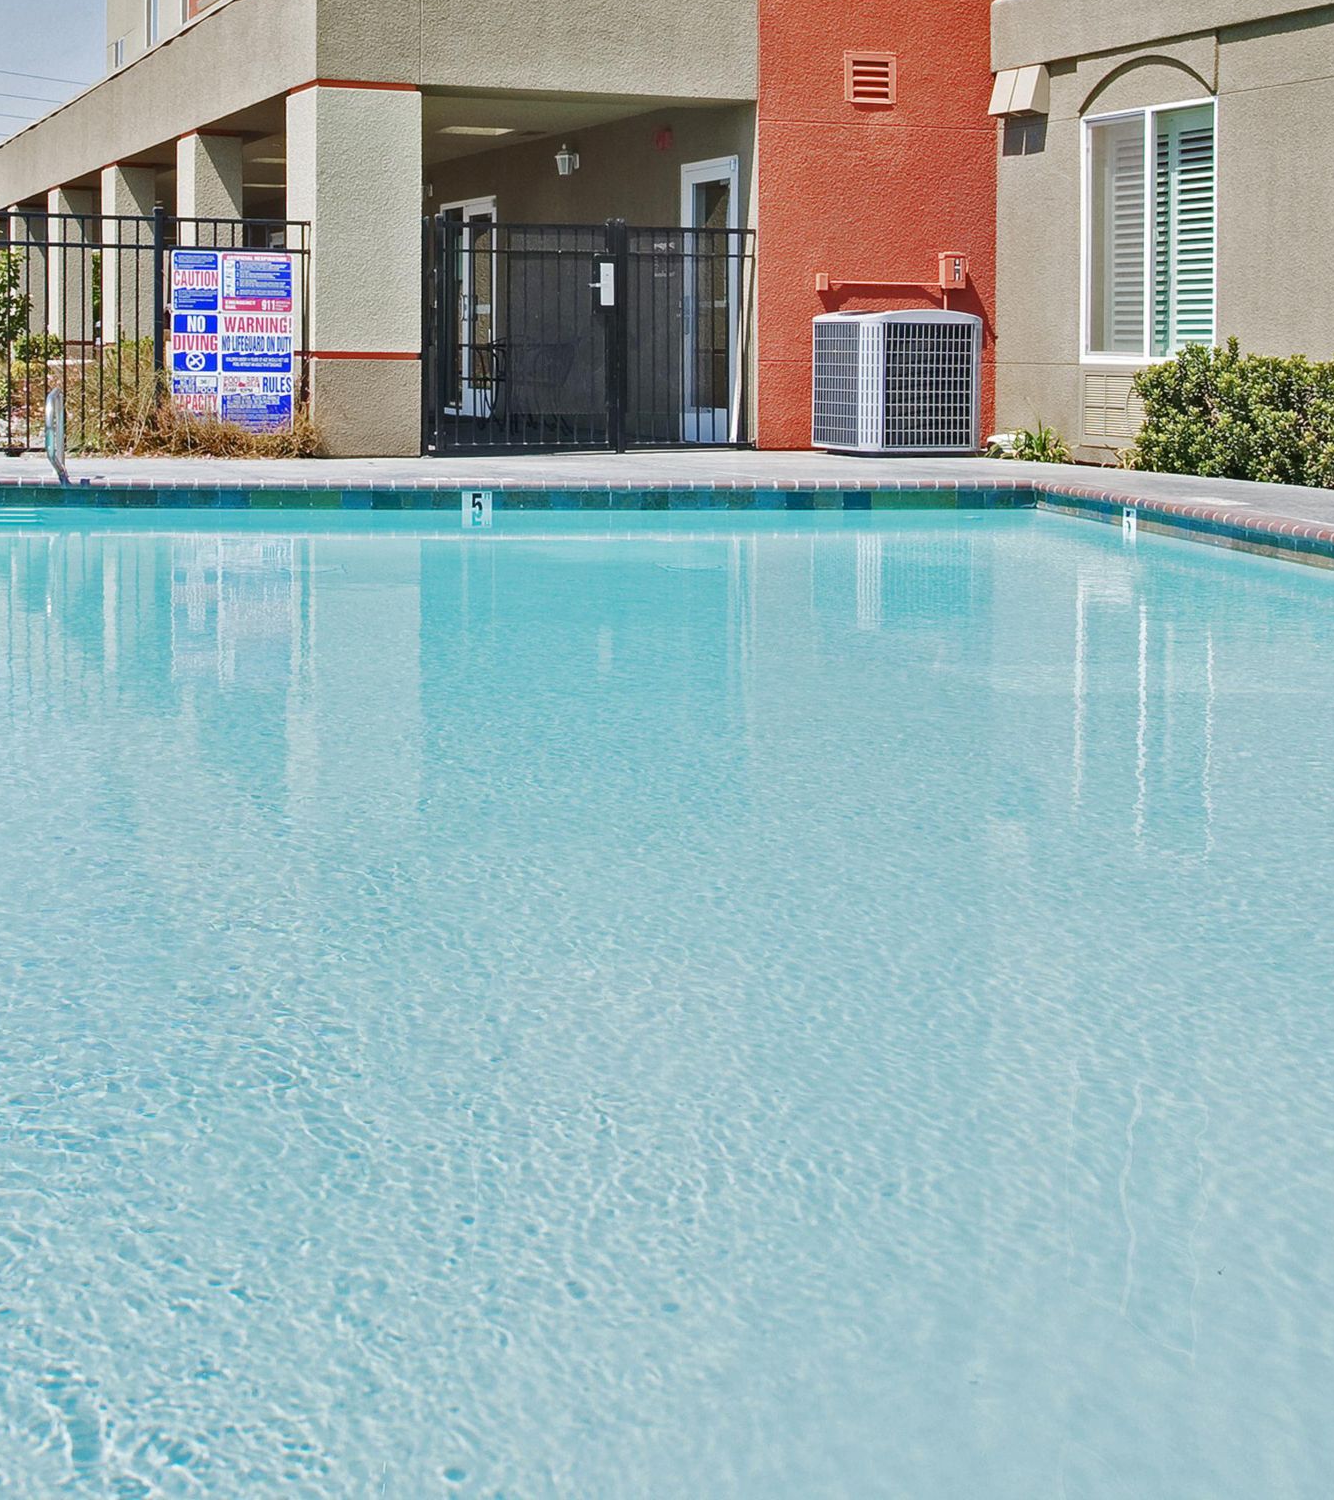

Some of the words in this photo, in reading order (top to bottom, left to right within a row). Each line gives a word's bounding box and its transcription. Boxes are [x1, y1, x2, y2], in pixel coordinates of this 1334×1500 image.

[174, 271, 218, 286] CAUTION
[261, 300, 275, 311] 911
[187, 315, 206, 332] NO
[224, 316, 292, 333] WARNING!
[173, 335, 218, 350] DIVING
[222, 336, 230, 351] NO
[232, 336, 265, 351] LIFEGUARD
[266, 336, 275, 352] ON
[277, 336, 292, 352] DUTY
[263, 377, 292, 393] RULES
[472, 493, 483, 511] 5
